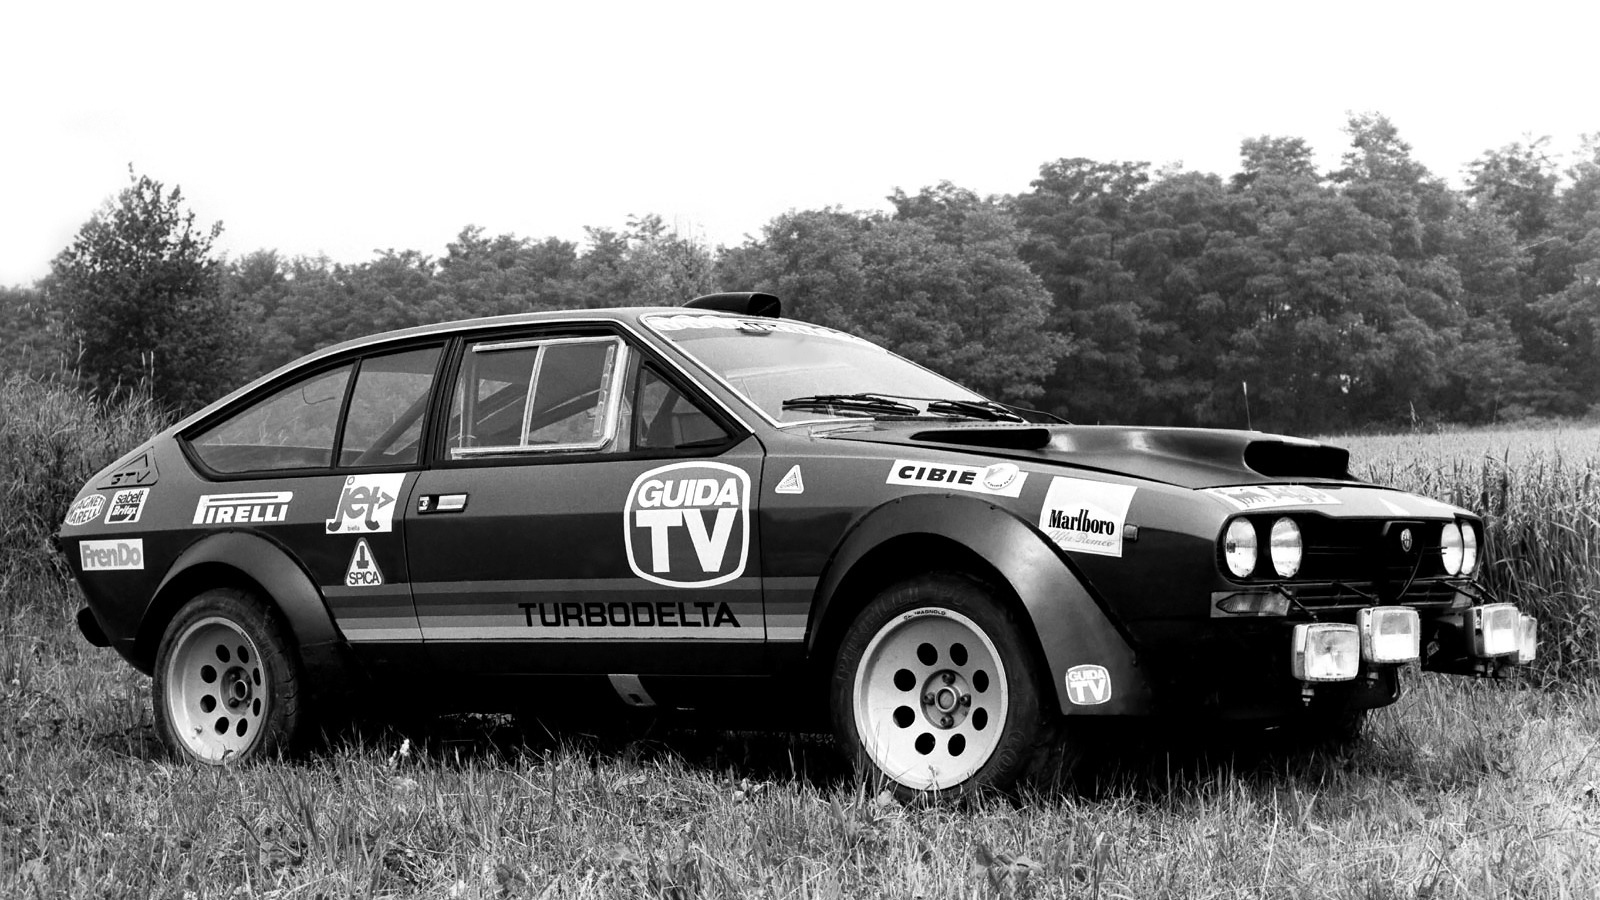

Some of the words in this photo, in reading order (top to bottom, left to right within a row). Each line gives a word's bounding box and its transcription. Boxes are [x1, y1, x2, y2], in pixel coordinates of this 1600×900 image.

[116, 490, 144, 504] sabelt
[637, 478, 740, 508] GUIDA
[192, 491, 294, 524] PIRELLI
[1048, 509, 1115, 535] Marlboro
[636, 508, 739, 574] TV
[82, 543, 142, 568] FrenDo
[349, 571, 380, 585] SPICA
[518, 602, 741, 628] TURBODELTA
[1068, 669, 1106, 681] GUIDA
[1070, 679, 1106, 702] TV
